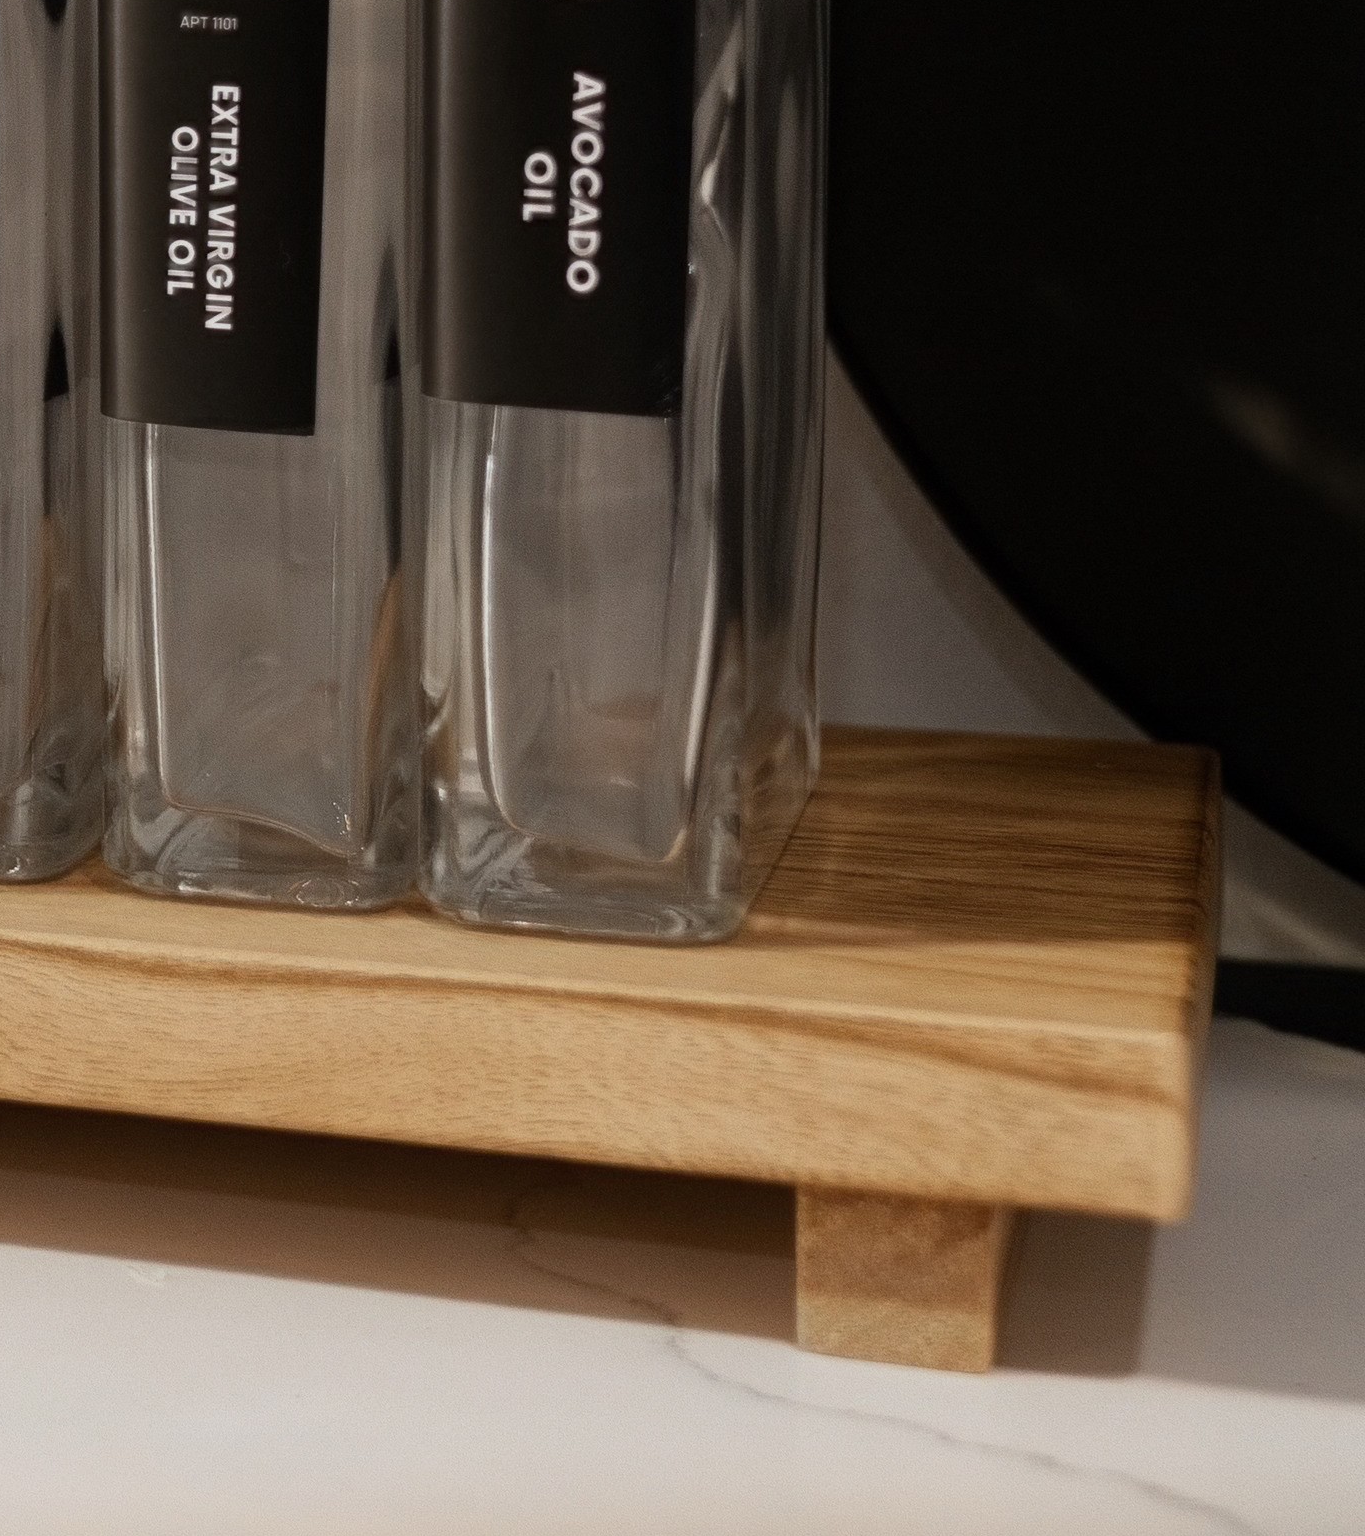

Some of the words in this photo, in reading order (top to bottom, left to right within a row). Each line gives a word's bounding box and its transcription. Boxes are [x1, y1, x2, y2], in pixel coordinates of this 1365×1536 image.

[180, 14, 209, 28] APT
[212, 16, 238, 31] 1101
[169, 126, 200, 226] OLIVE
[209, 84, 240, 191] EXTRA
[522, 151, 557, 221] OIL
[566, 72, 605, 294] AVOCADO
[166, 239, 196, 295] OIL
[204, 204, 236, 331] VIRGIN
